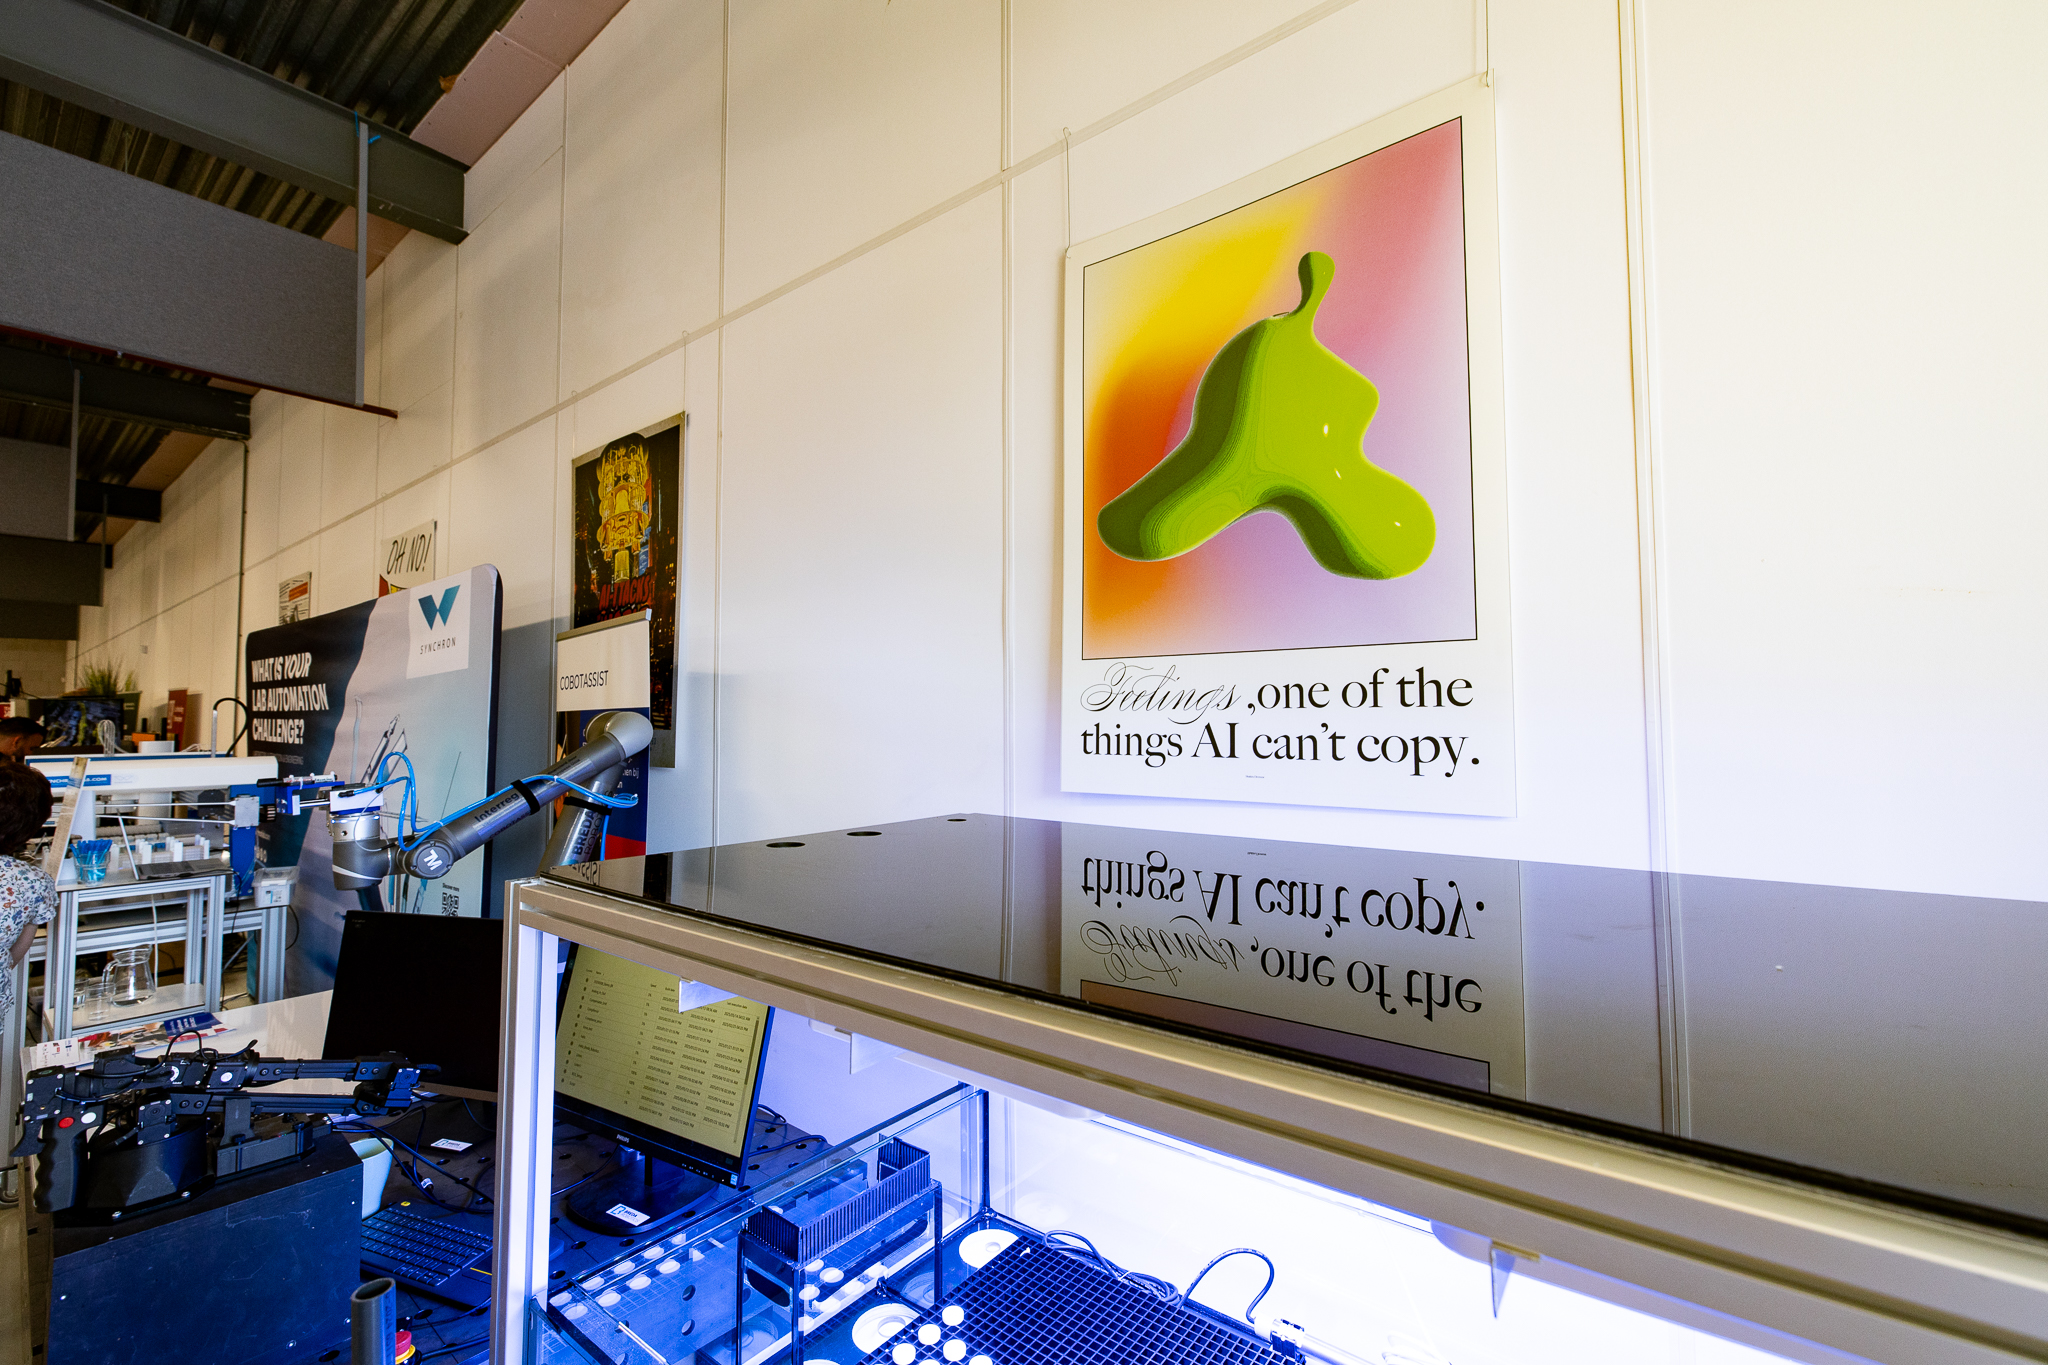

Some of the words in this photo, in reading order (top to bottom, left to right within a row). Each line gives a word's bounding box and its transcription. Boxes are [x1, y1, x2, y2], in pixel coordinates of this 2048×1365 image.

[386, 537, 408, 575] OH
[406, 533, 432, 573] NO!
[419, 636, 456, 655] SYNCHRON
[251, 658, 274, 683] WHAT
[274, 656, 284, 680] IS
[284, 652, 312, 679] YOUR
[560, 670, 609, 691] COBOTASSIST
[252, 688, 267, 712] LAB
[267, 683, 329, 712] AUTOMATION
[1080, 661, 1242, 725] Feelings
[1341, 667, 1390, 709] of
[1396, 666, 1474, 708] the
[252, 718, 305, 745] CHALLENGE?
[1080, 722, 1183, 769] things
[1190, 722, 1240, 759] AI
[1252, 722, 1347, 762] can't
[1357, 735, 1480, 778] copy.
[474, 792, 521, 823] Interreg
[571, 810, 595, 856] BREDA
